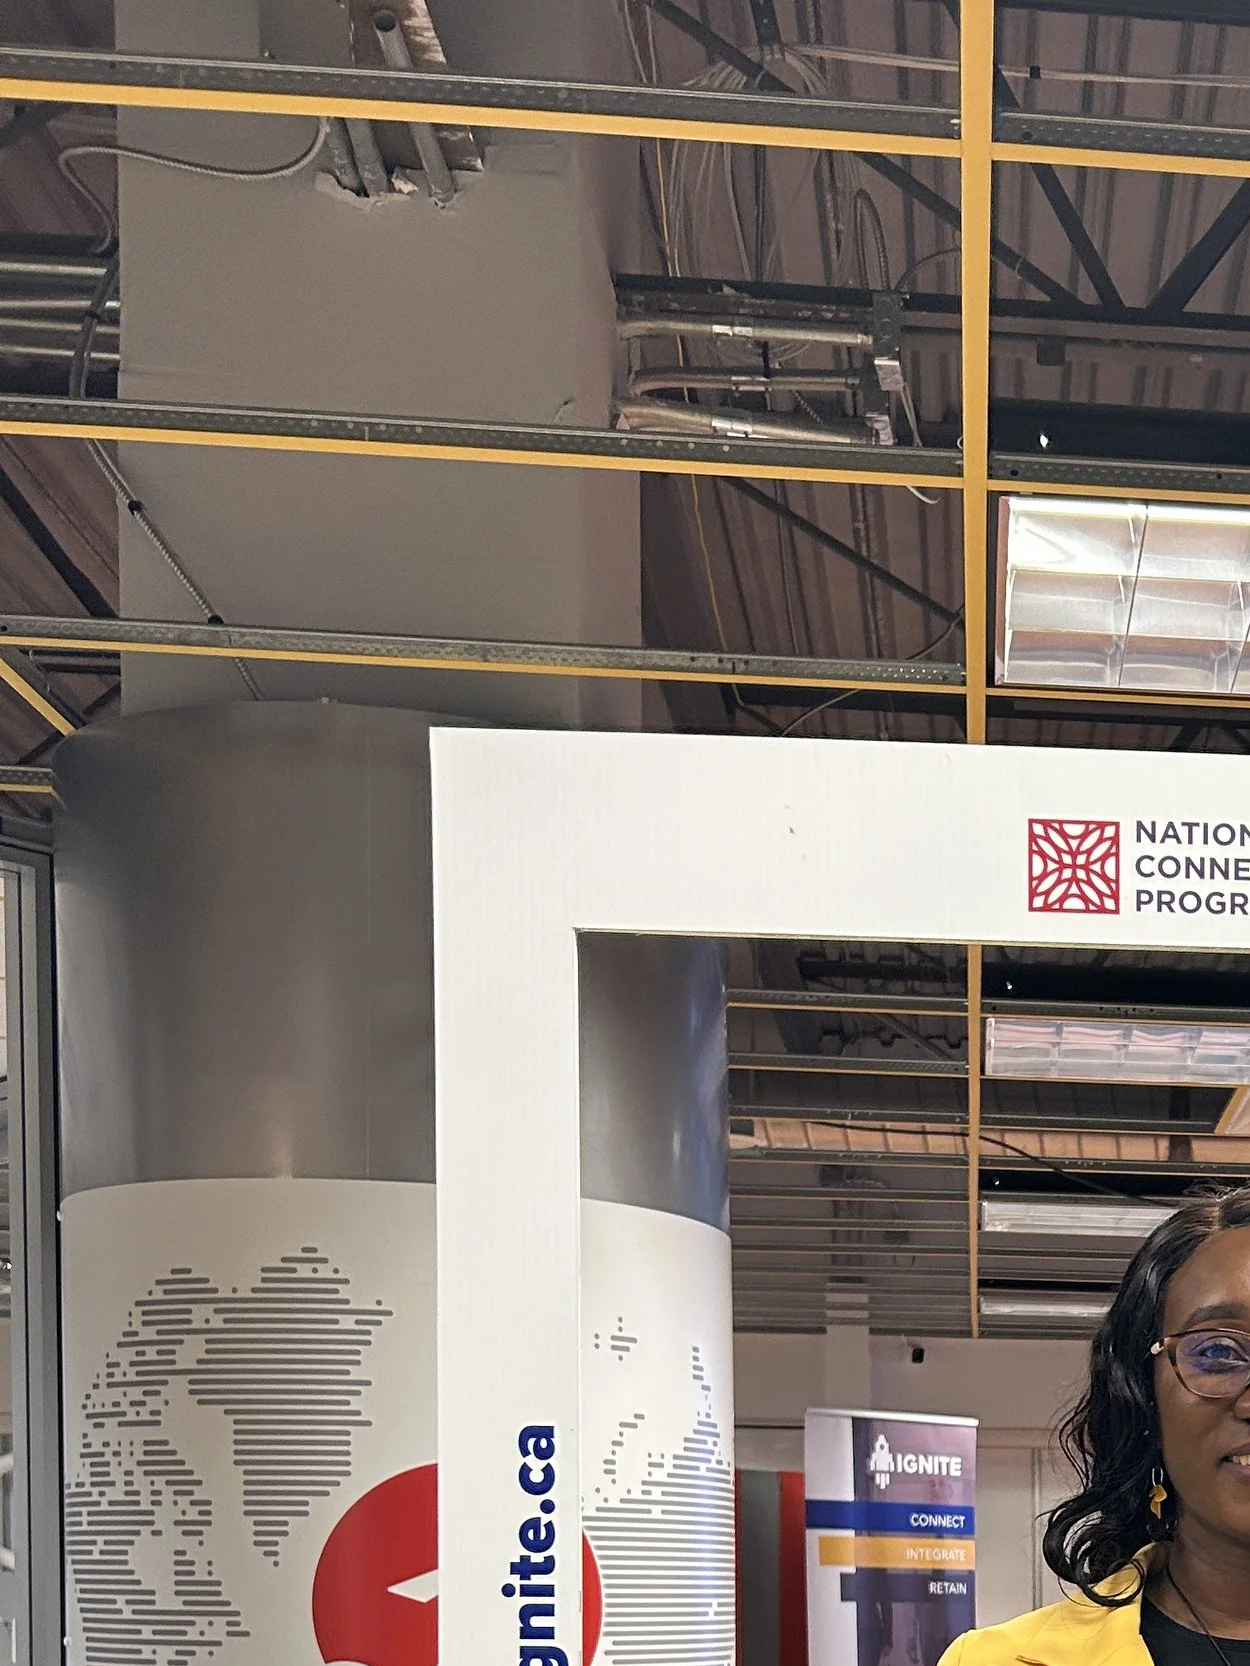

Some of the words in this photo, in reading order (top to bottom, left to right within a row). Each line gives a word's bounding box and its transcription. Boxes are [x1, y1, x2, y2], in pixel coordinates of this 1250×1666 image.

[896, 1453, 962, 1477] IGNITE
[909, 1512, 967, 1529] CONNECT
[905, 1547, 967, 1562] INTEGRATE
[928, 1580, 968, 1595] RETAIN
